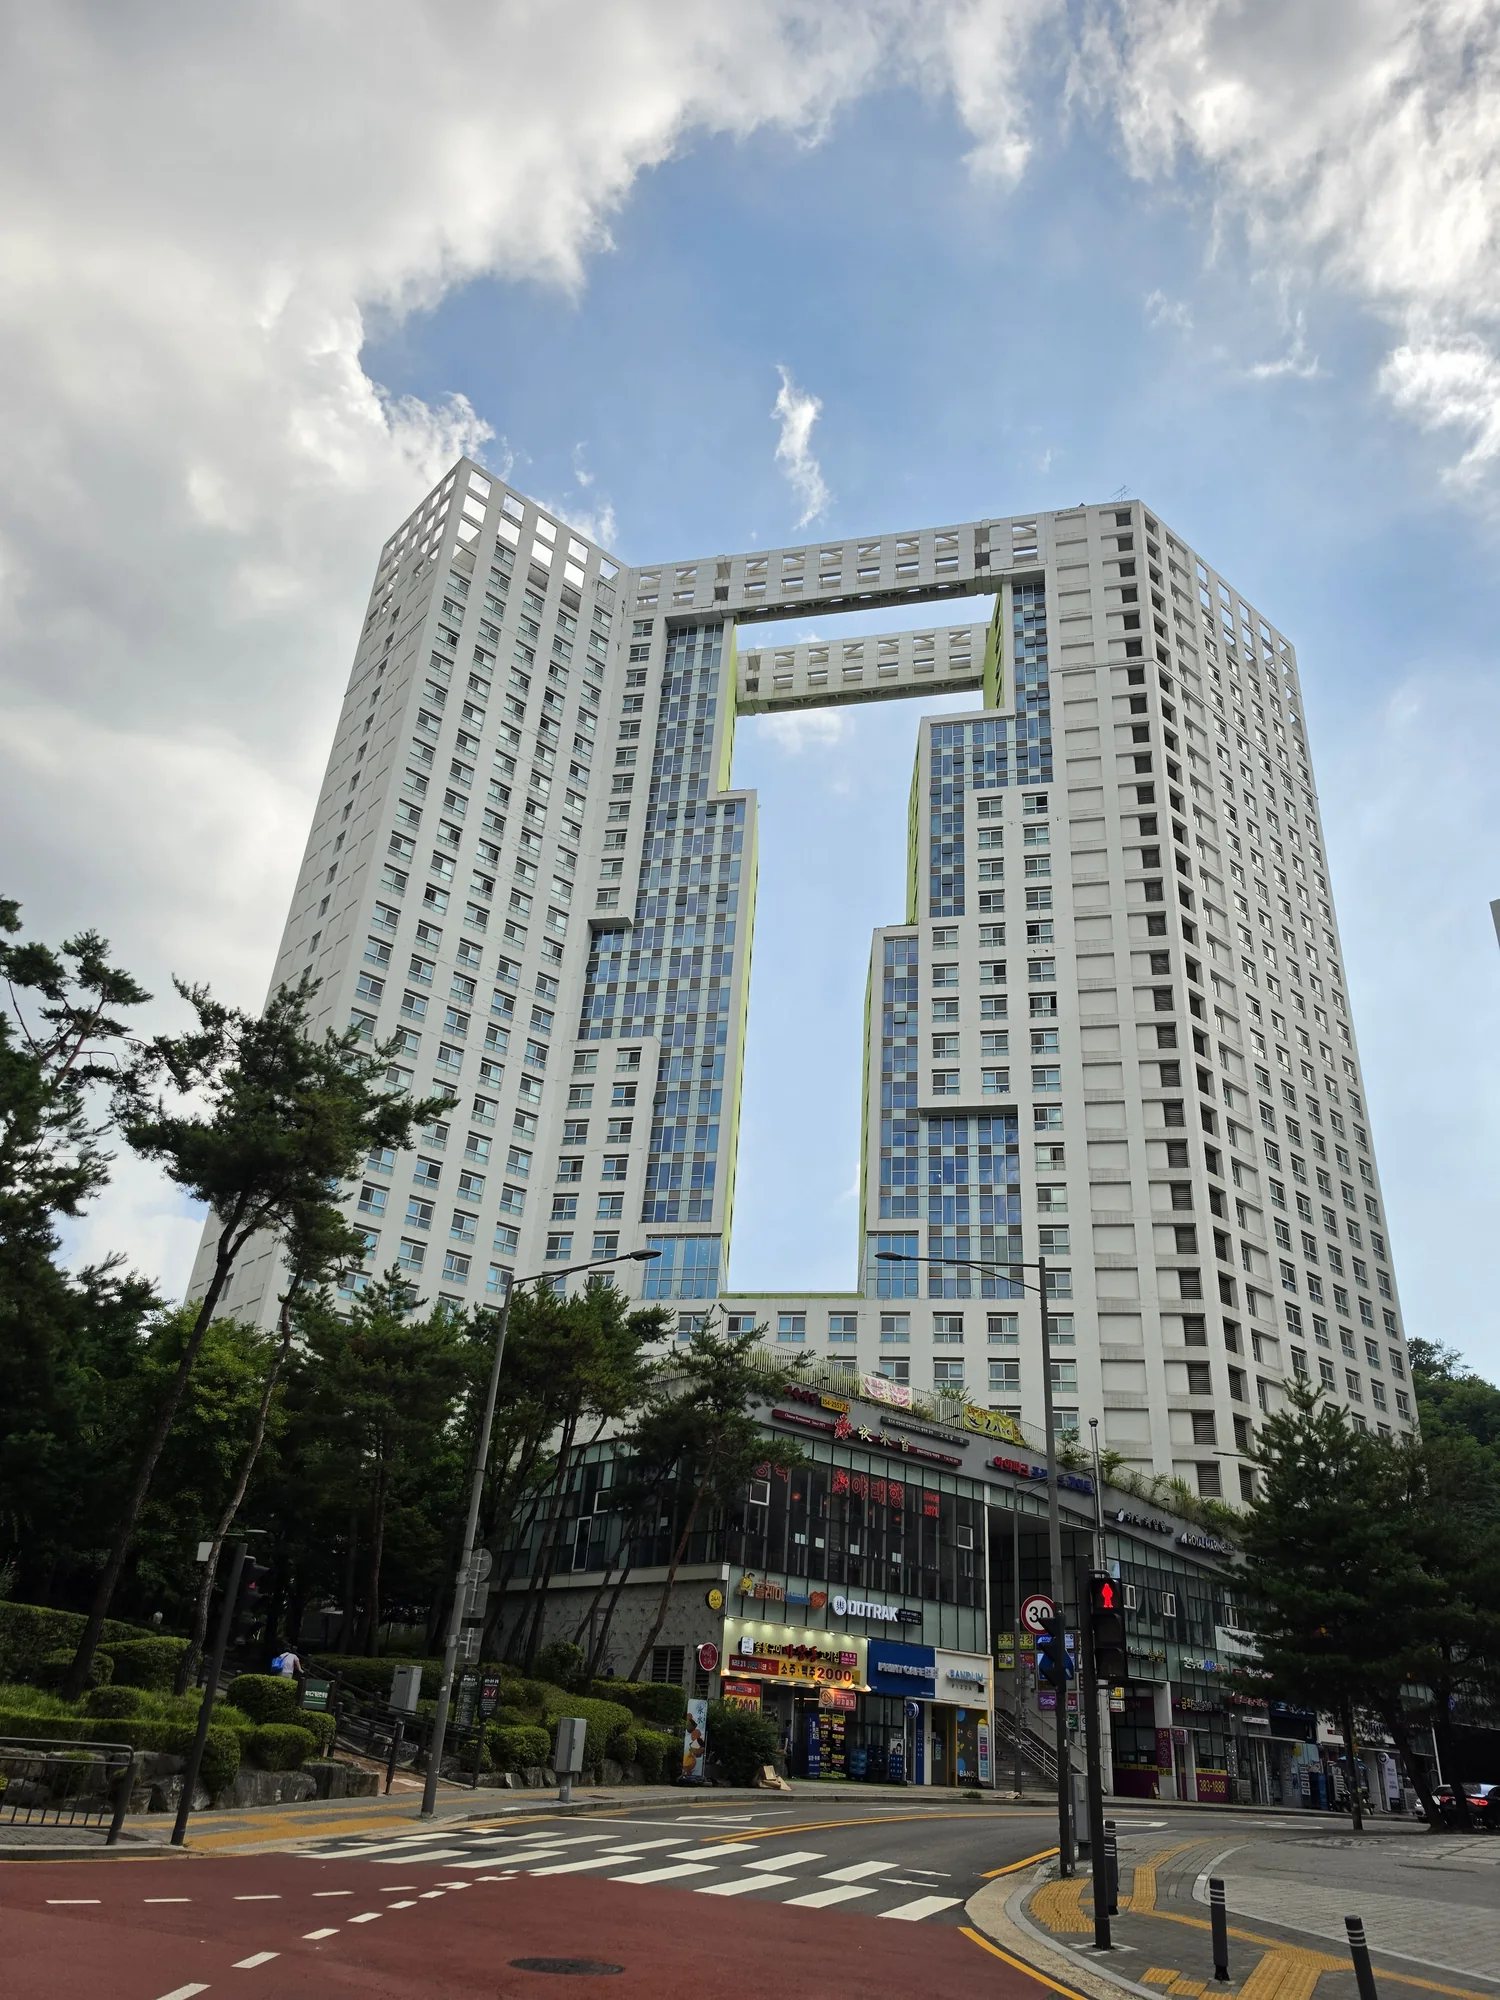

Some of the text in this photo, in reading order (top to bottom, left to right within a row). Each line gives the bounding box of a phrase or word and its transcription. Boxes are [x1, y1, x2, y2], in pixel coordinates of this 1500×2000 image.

[993, 1456, 1031, 1480] 아이파크
[851, 1474, 904, 1508] 야래향
[847, 1599, 899, 1622] DOTRAK
[1029, 1606, 1050, 1623] 30
[999, 1634, 1014, 1644] 주차
[755, 1641, 840, 1663] 숯불구이 마장동 고기집
[817, 1666, 852, 1682] 2000
